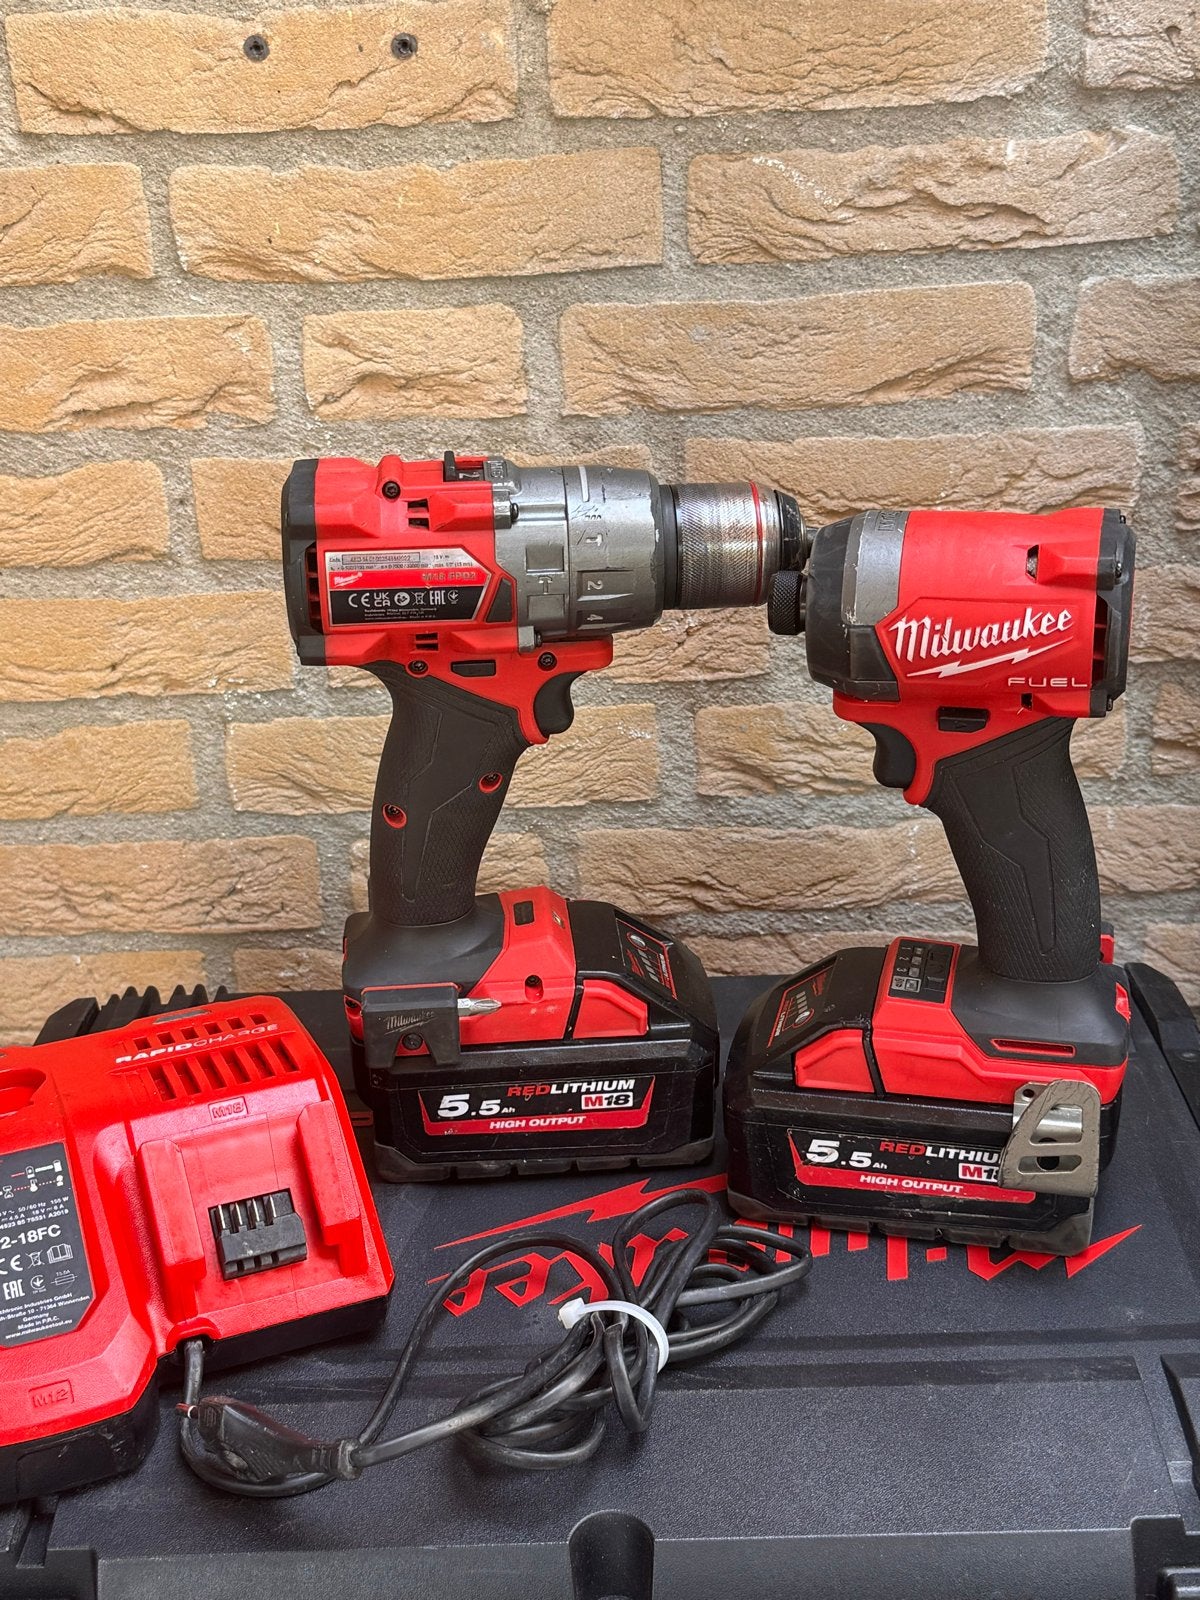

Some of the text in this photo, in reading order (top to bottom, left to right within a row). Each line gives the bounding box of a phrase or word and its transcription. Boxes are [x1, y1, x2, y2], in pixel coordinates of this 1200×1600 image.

[587, 580, 603, 590] 2
[586, 613, 603, 621] 4
[888, 606, 1074, 663] Milwaukee
[1007, 677, 1088, 688] FUEL
[115, 1023, 278, 1064] RAPIDCHARGE
[507, 1080, 635, 1097] REDLITHIUM
[583, 1093, 632, 1108] M18
[211, 1101, 244, 1119] M18
[489, 1116, 587, 1130] HIGH OUTPUT
[879, 1141, 1001, 1164] REDLITHIU
[859, 1174, 964, 1194] HIGH OUTPUT
[24, 1298, 53, 1308] Industries
[54, 1292, 72, 1301] GmbH
[57, 1295, 90, 1307] Winnenden
[23, 1312, 49, 1322] Germany
[17, 1322, 35, 1330] Made
[32, 1388, 68, 1408] M12
